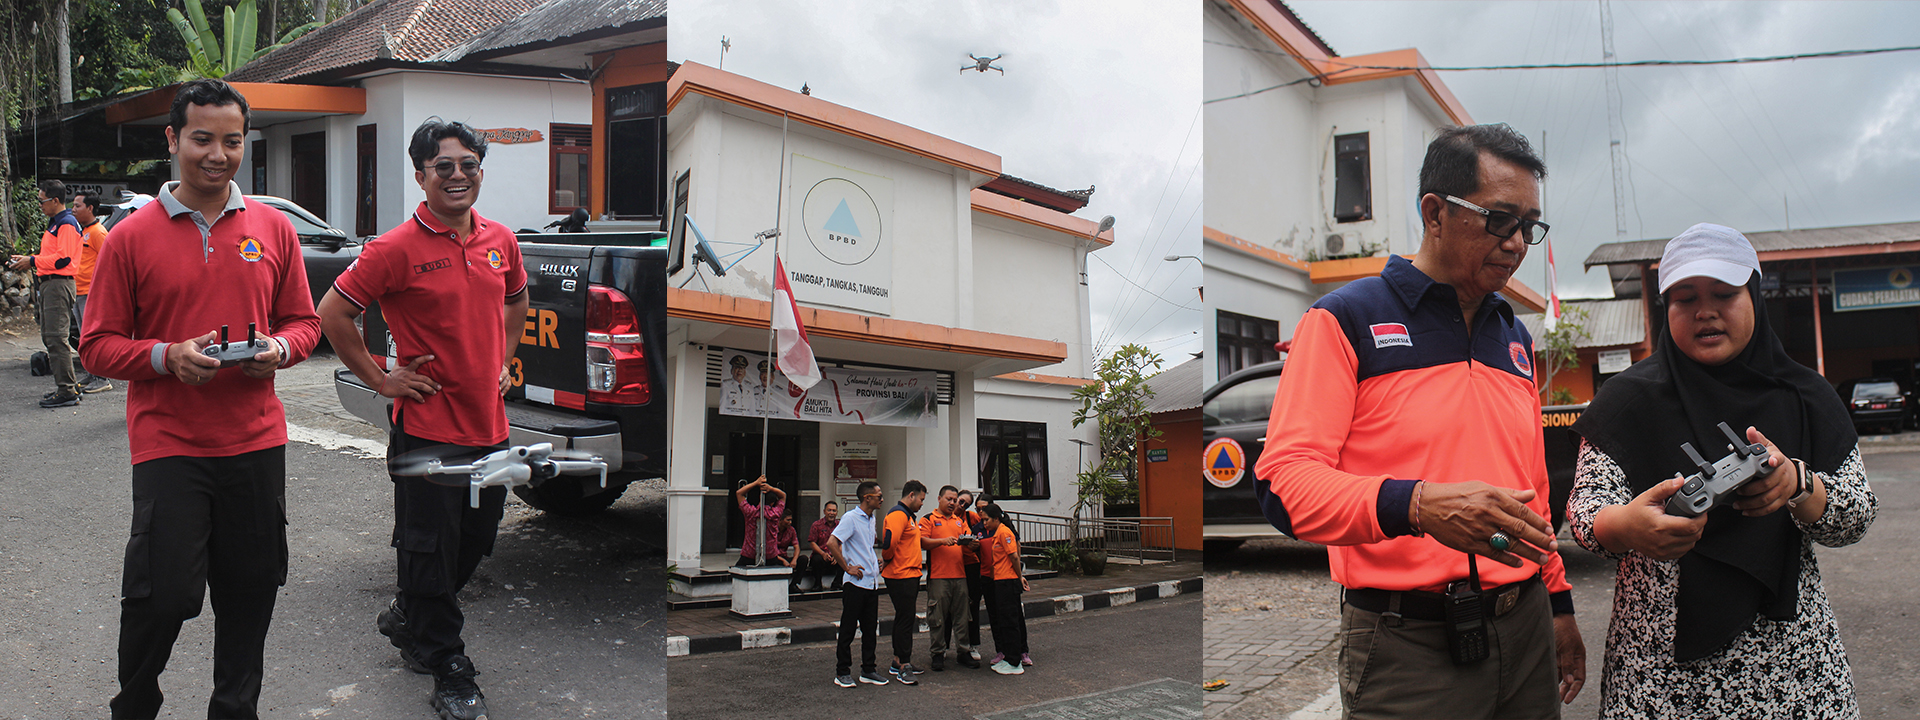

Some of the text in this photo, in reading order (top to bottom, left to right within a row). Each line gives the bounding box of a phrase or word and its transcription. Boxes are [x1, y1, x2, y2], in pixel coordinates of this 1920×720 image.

[829, 233, 856, 245] BPBD
[421, 260, 447, 272] BUDI
[540, 263, 580, 277] HILUX
[791, 271, 889, 298] TANGGAP, TANGKAS, TANGGUH
[1839, 291, 1874, 307] GUDANG
[844, 374, 870, 386] Selamat
[870, 376, 883, 387] Hari
[883, 377, 897, 389] Jadi
[856, 388, 908, 400] PROVINSI BALI
[805, 398, 829, 407] AMUKTI
[804, 405, 833, 414] BALI HITA
